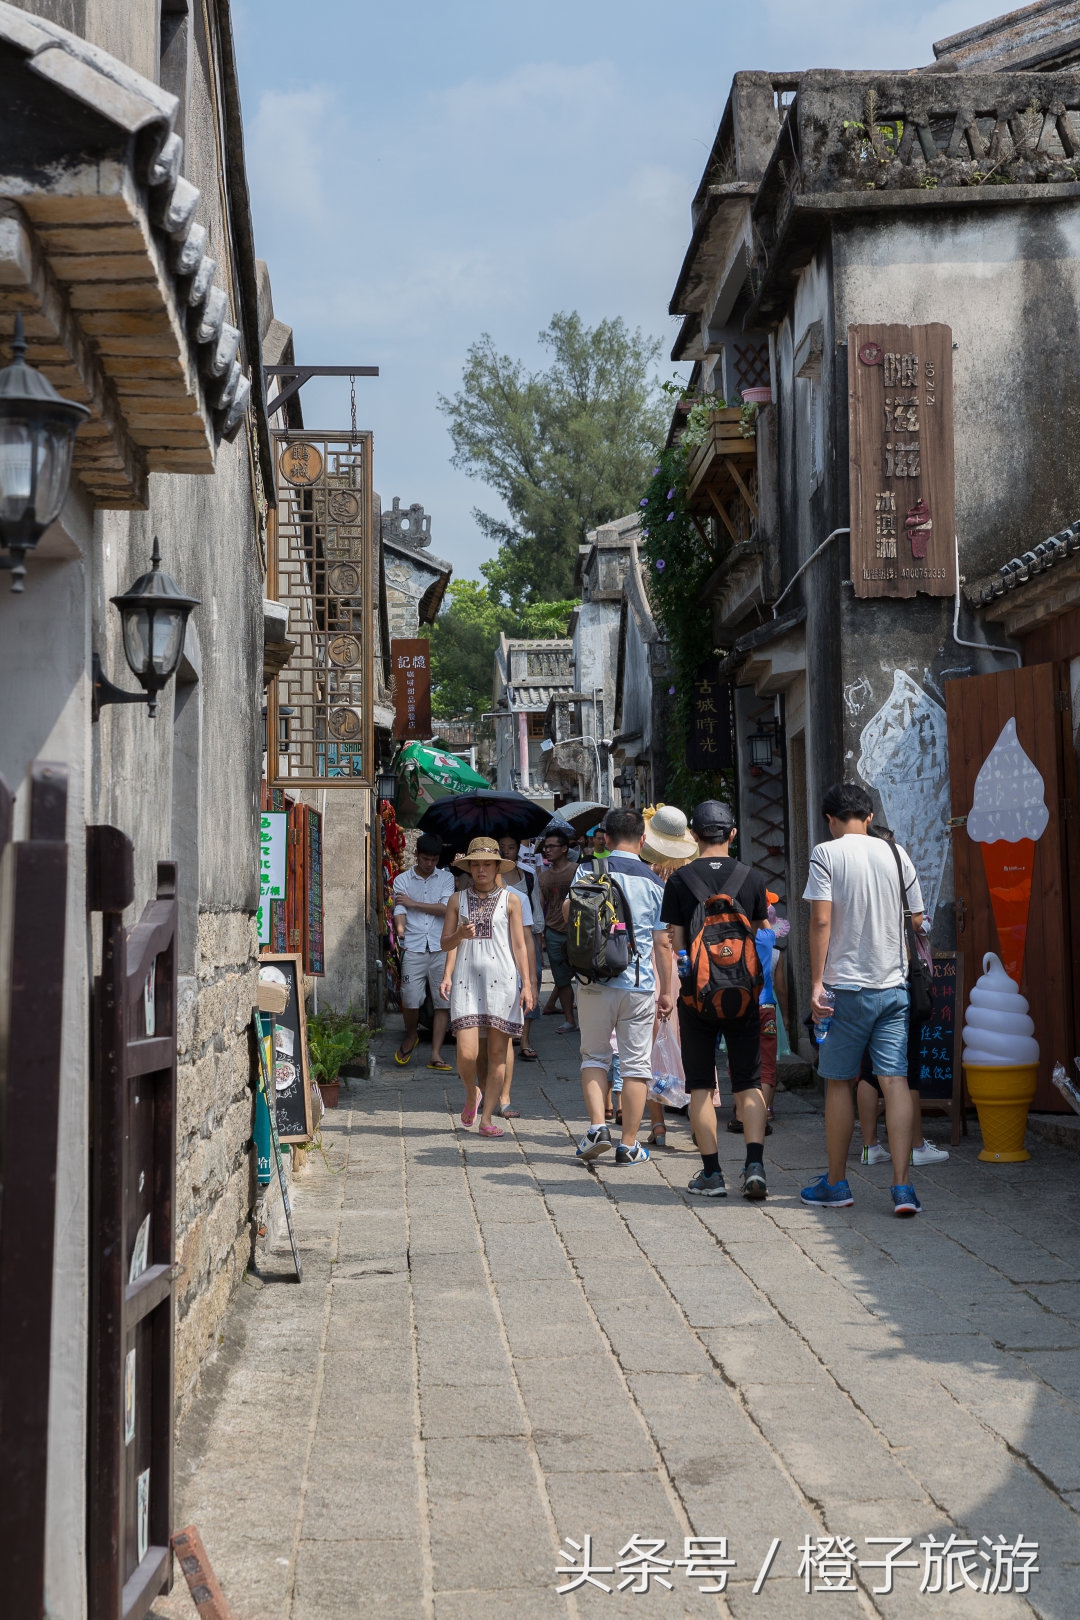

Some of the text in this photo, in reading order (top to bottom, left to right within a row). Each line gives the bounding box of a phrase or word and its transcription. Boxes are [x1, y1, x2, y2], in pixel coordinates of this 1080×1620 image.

[884, 352, 920, 477] 啵滋滋
[875, 490, 897, 558] 冰淇淋
[397, 655, 426, 669] 記憶
